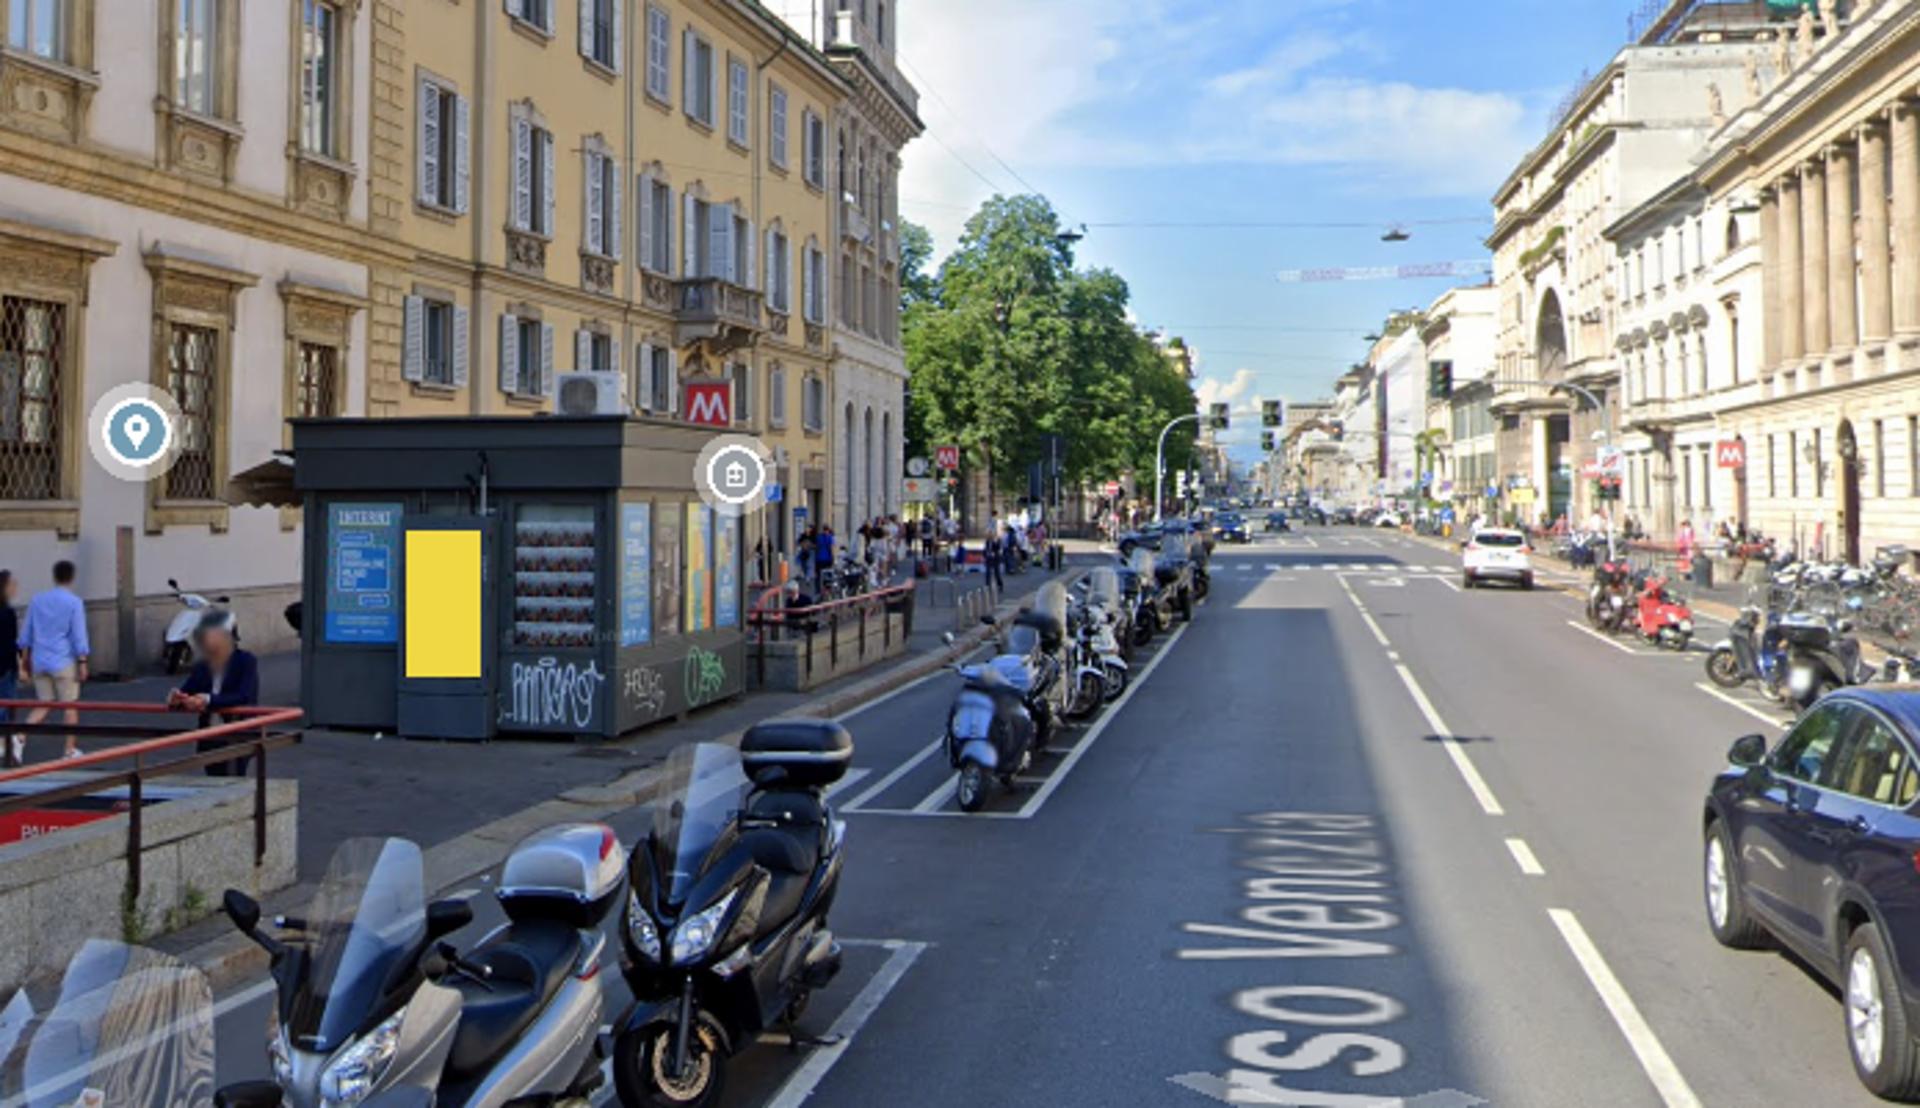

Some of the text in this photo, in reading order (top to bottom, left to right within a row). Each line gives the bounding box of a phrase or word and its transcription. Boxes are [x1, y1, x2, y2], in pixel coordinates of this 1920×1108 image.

[688, 391, 727, 422] M
[937, 450, 956, 465] M
[1719, 447, 1742, 462] M
